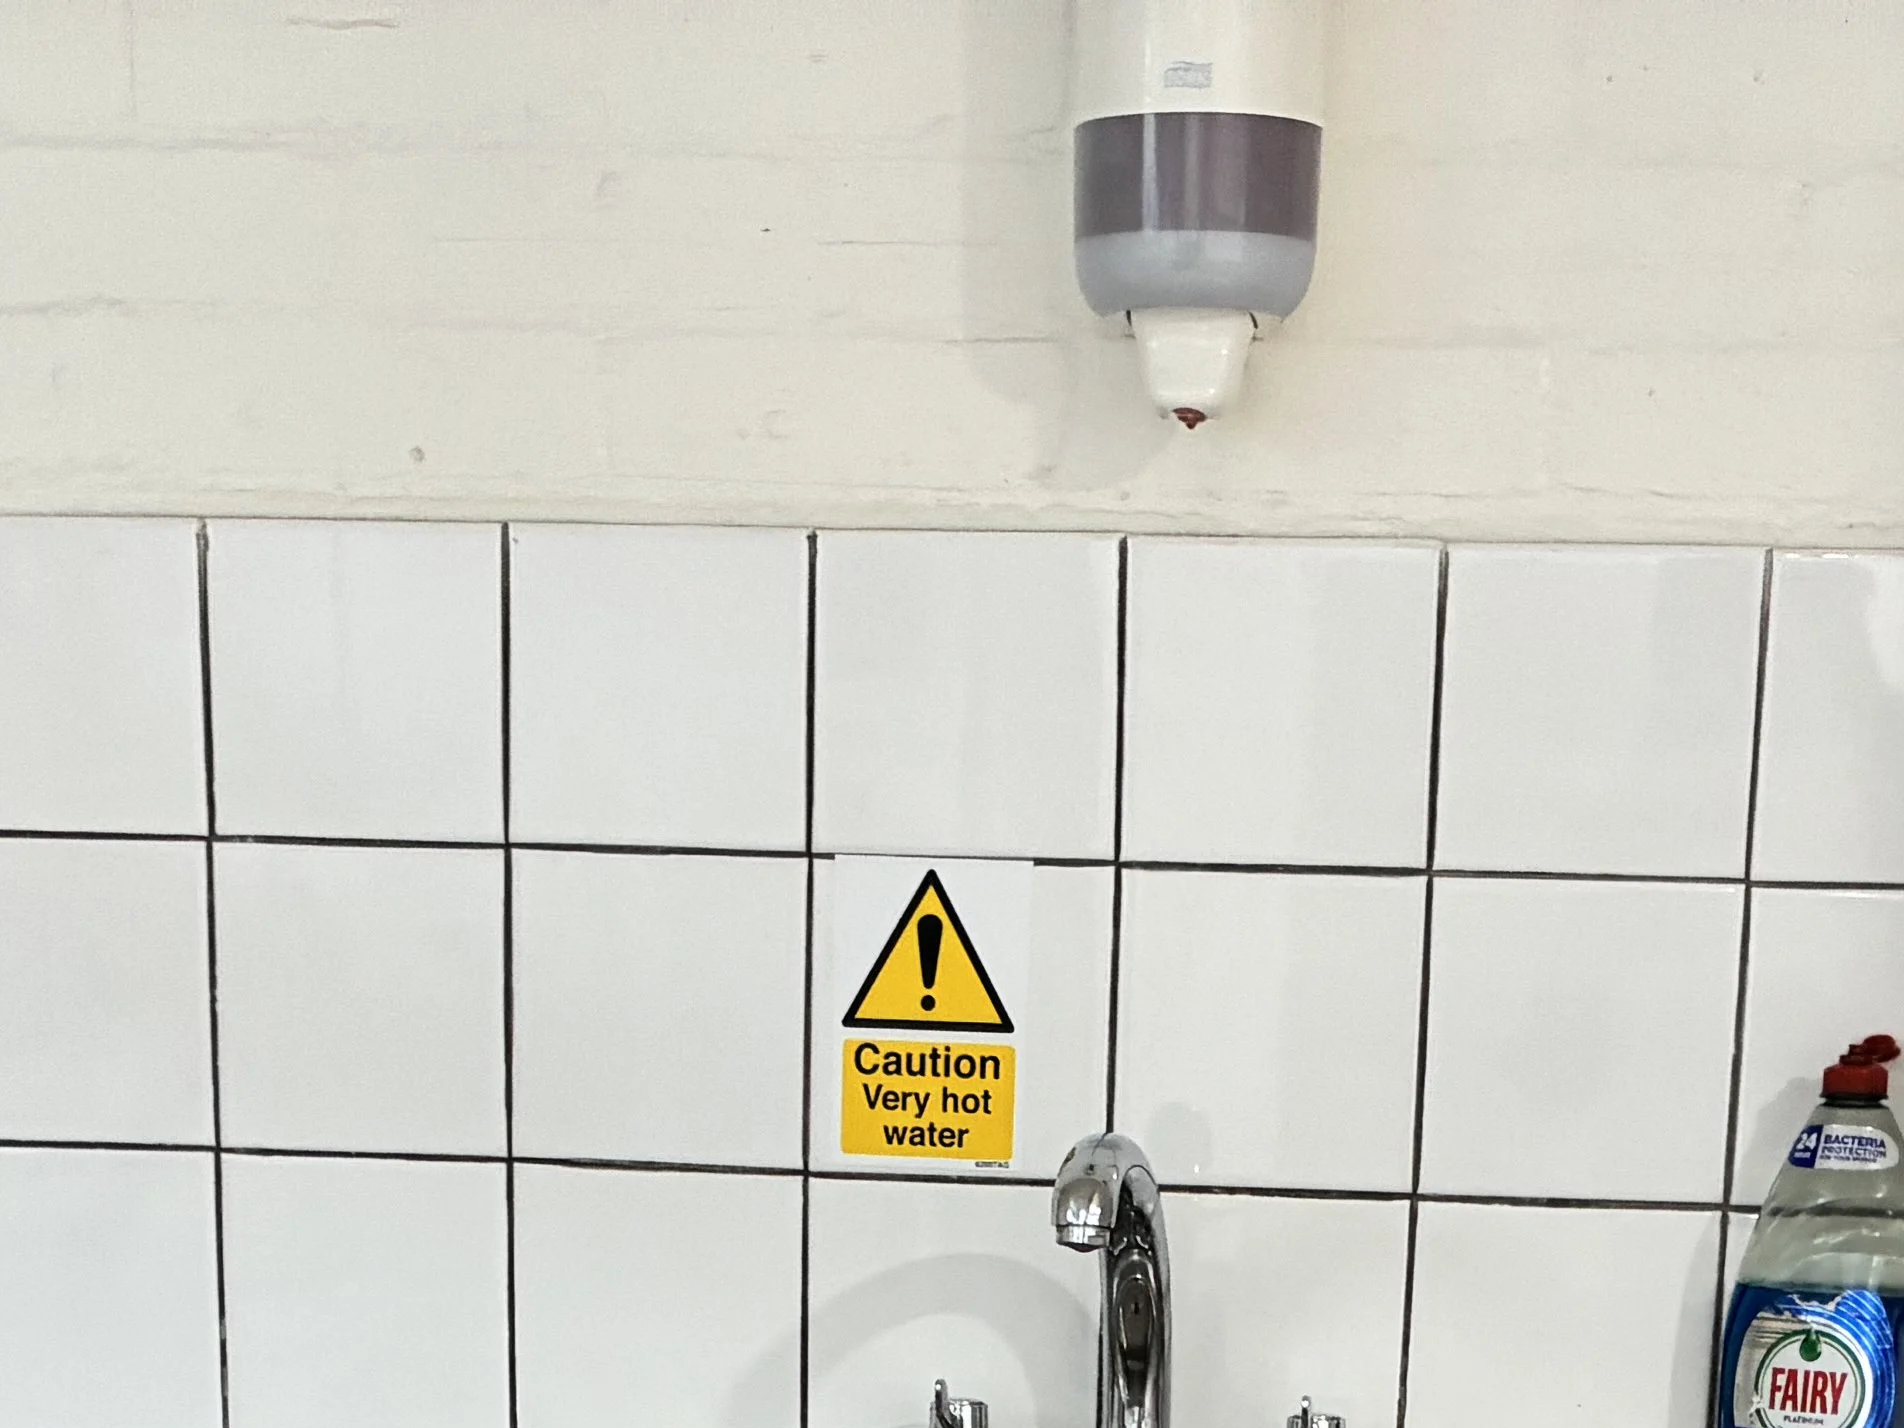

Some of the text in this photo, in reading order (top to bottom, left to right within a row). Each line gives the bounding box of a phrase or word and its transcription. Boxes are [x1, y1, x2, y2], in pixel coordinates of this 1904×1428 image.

[853, 1042, 1001, 1080] Caution
[862, 1083, 992, 1119] Very hot
[883, 1122, 970, 1148] water
[1796, 1132, 1818, 1150] 24
[1822, 1134, 1886, 1149] BACTERIA
[1821, 1146, 1887, 1158] PROTECTION
[1767, 1366, 1848, 1416] FAIRY
